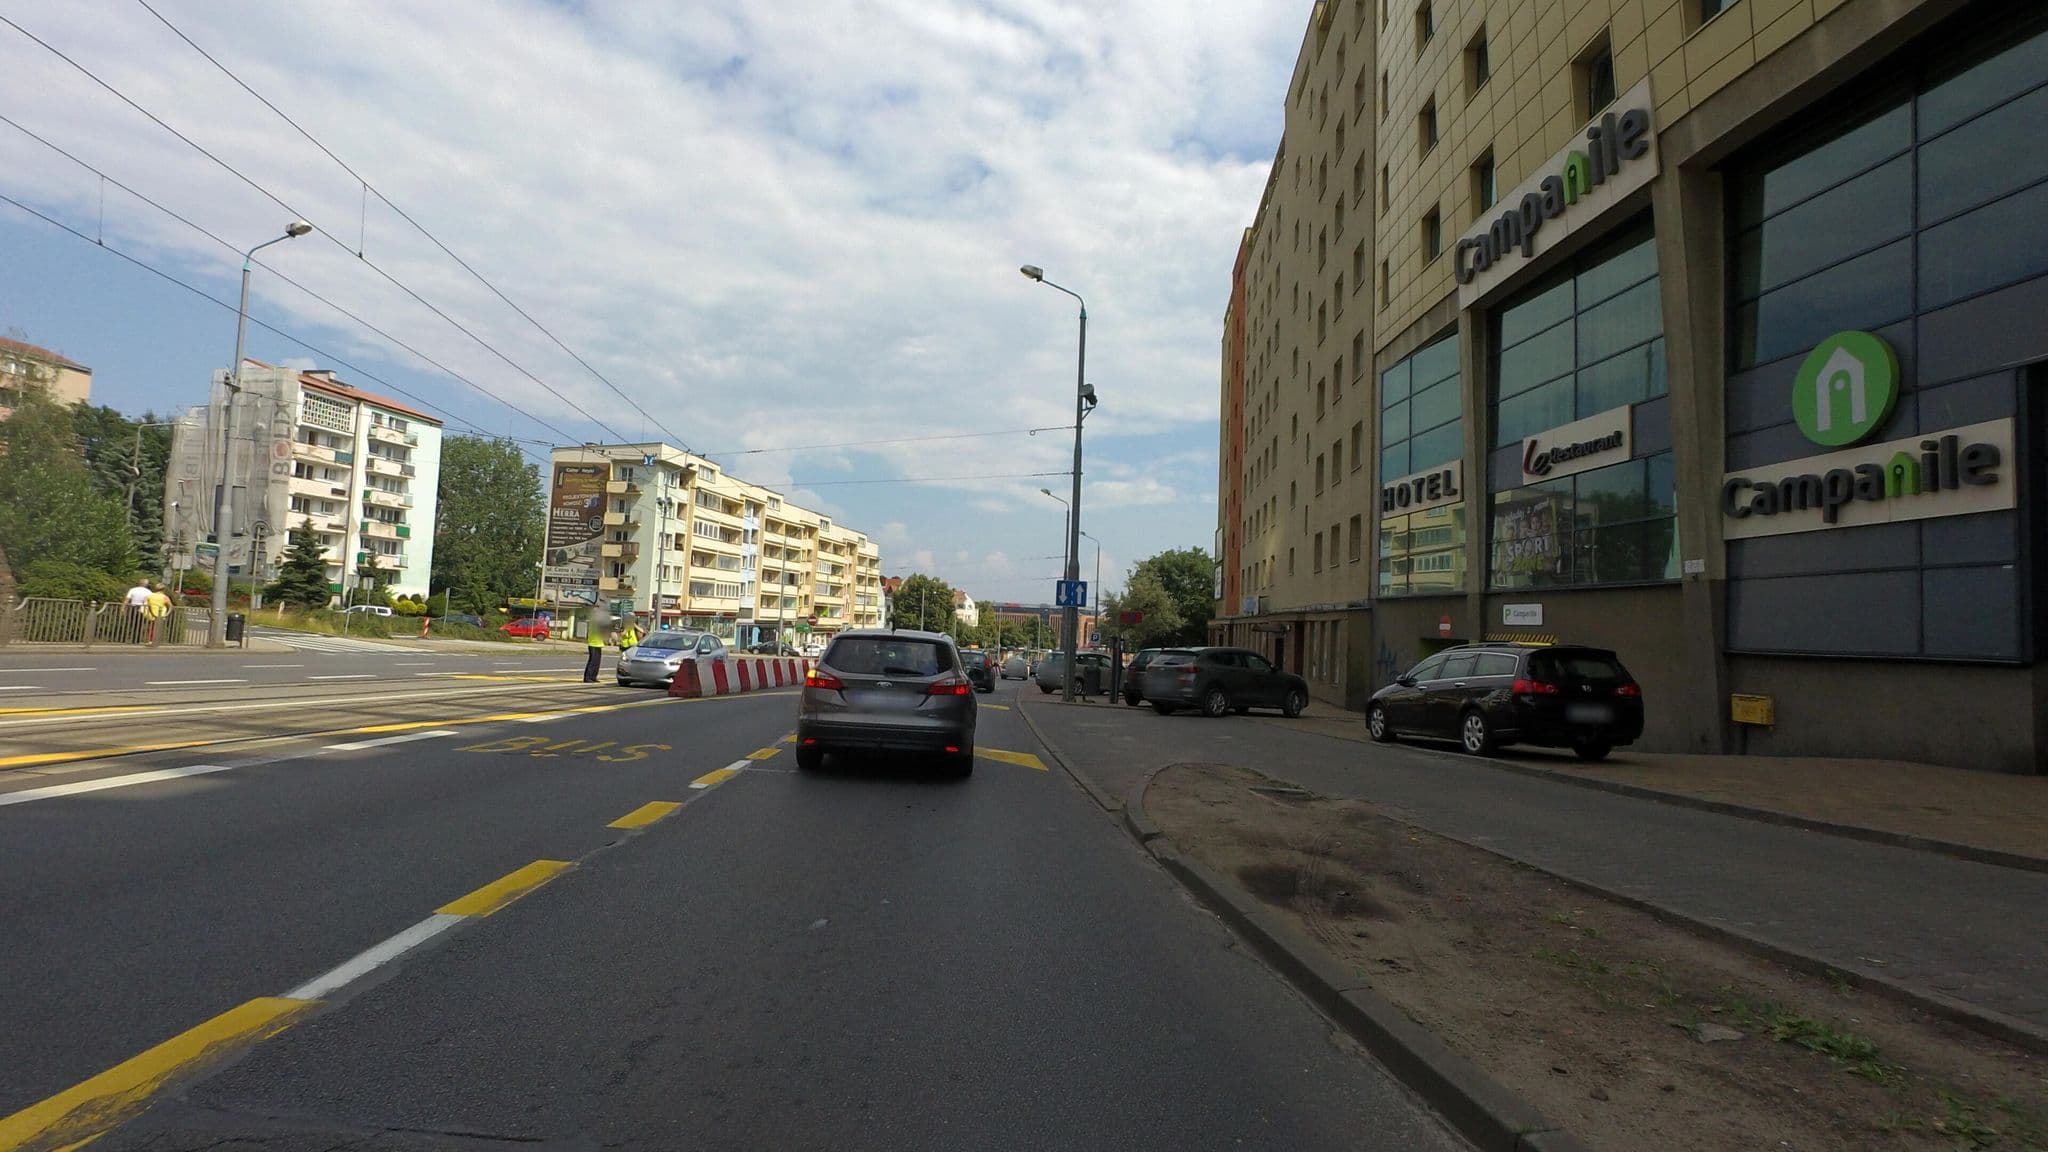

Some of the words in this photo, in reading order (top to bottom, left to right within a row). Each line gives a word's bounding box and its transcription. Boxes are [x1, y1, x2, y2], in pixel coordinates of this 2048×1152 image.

[1456, 108, 1650, 284] Campanile
[1382, 470, 1457, 512] HOTEL
[1722, 435, 2001, 523] Campanile
